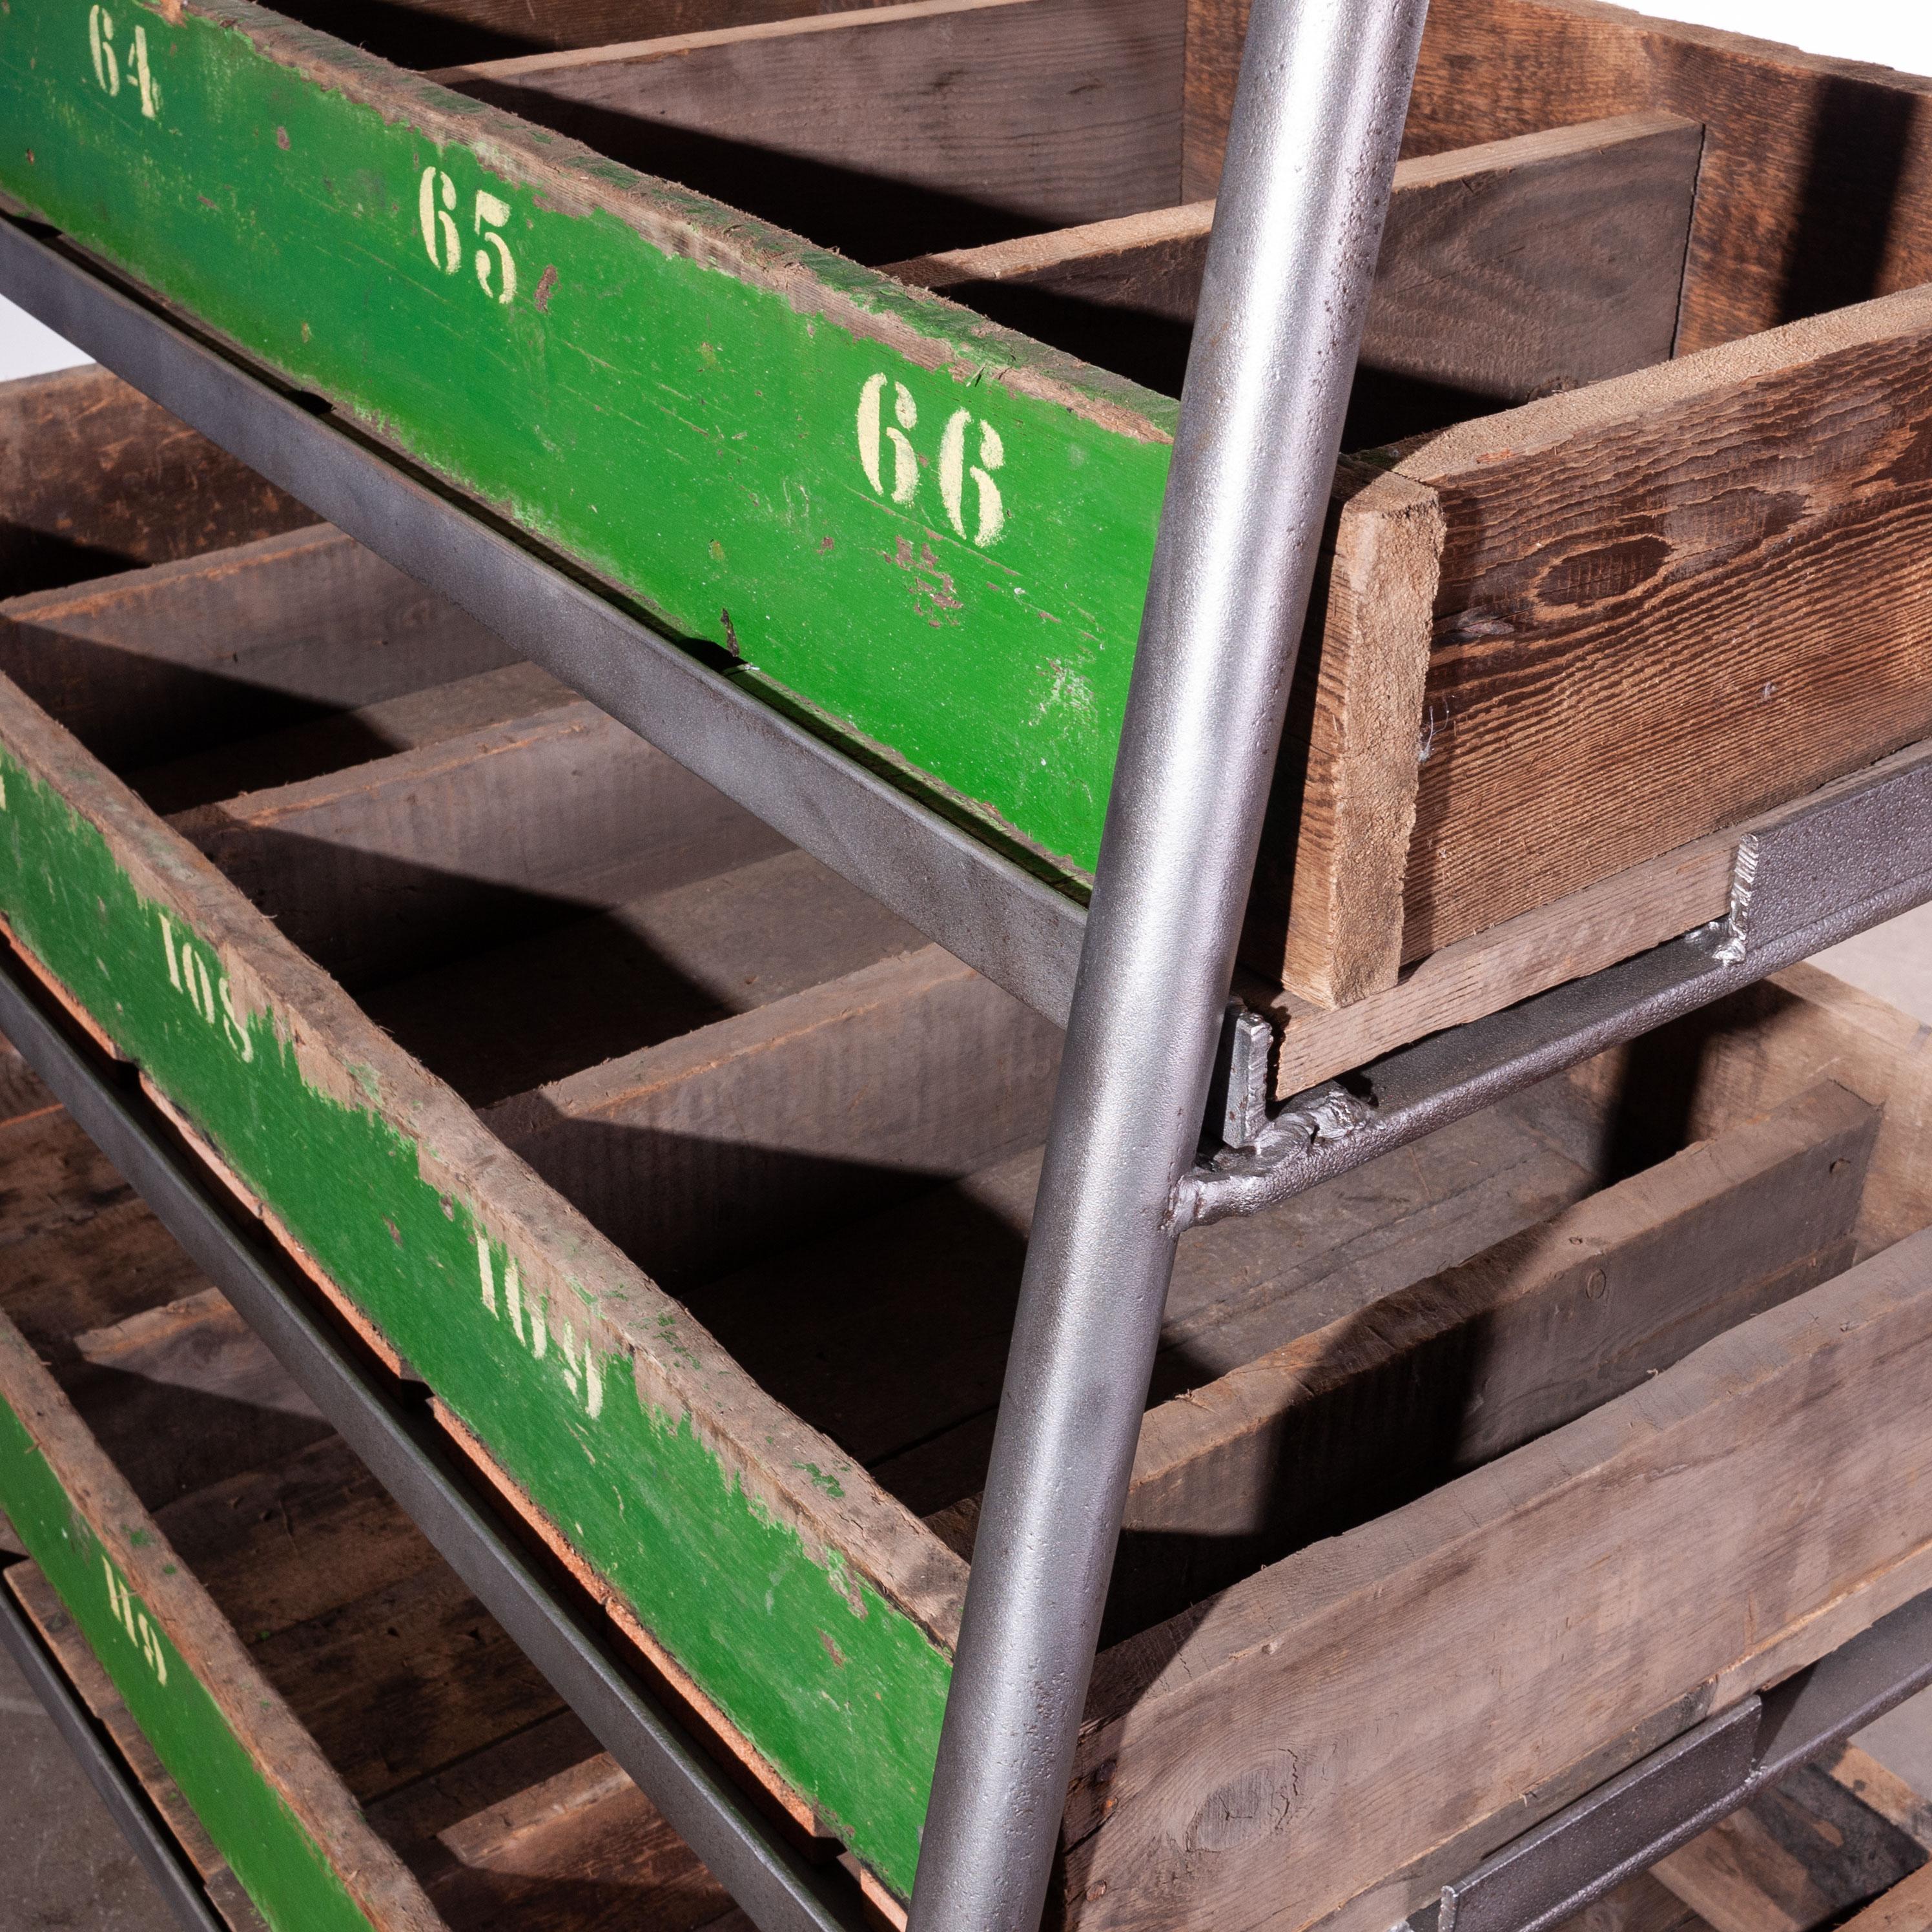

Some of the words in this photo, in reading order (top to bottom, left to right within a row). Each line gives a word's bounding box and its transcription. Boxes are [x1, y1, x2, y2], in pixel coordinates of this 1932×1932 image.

[89, 5, 163, 120] 64
[420, 167, 517, 304] 65
[856, 372, 1006, 548] 66
